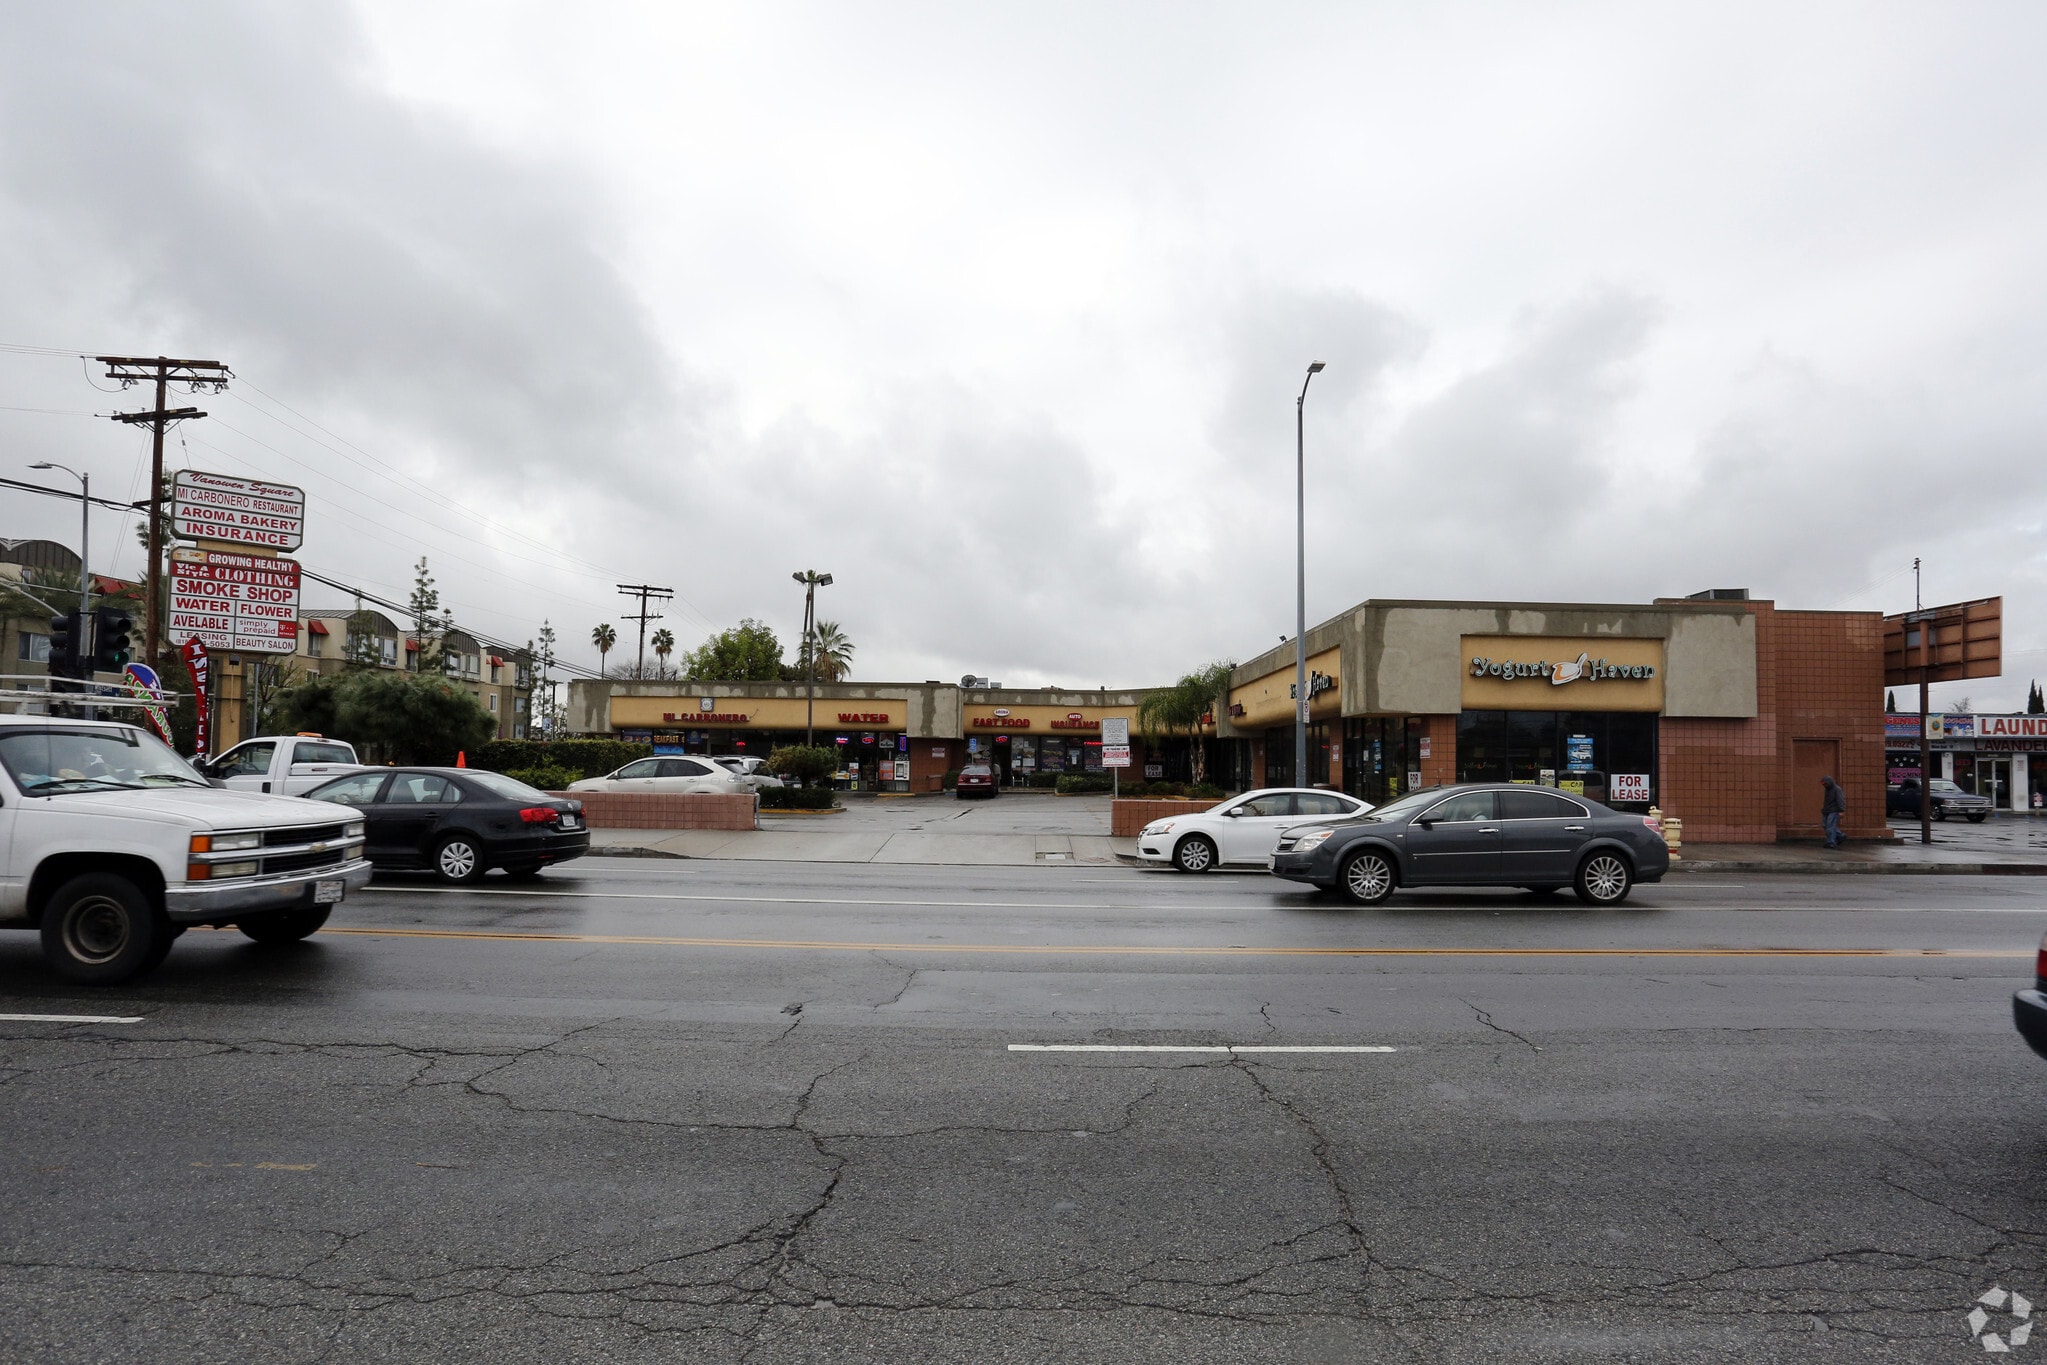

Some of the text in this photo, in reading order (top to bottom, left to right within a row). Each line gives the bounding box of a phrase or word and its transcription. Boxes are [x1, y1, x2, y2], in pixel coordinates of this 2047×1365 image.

[189, 471, 295, 497] Vanowen Square
[177, 487, 298, 515] MI CARBONERO RESTAURANT
[181, 506, 298, 531] AROMA BAKERY
[186, 522, 289, 545] INSURANCE
[208, 553, 294, 572] GROWING HEALTHY
[214, 567, 294, 587] CLOTHING
[176, 578, 293, 603] SMOKE SHOP
[175, 597, 230, 613] WATER
[240, 603, 292, 618] FLOWER
[173, 615, 229, 630] AVELABLE
[239, 620, 269, 629] simply
[180, 631, 227, 641] LEASING
[243, 626, 276, 635] prepaid
[235, 637, 293, 650] BEAUTY SALON
[1472, 656, 1655, 681] Yogurt Haven
[663, 713, 676, 722] MI
[838, 713, 889, 723] WATER
[973, 718, 1030, 728] FAST FOOD
[1981, 719, 2047, 735] LAUND
[1618, 775, 1642, 787] FOR
[1612, 789, 1648, 800] LEASE
